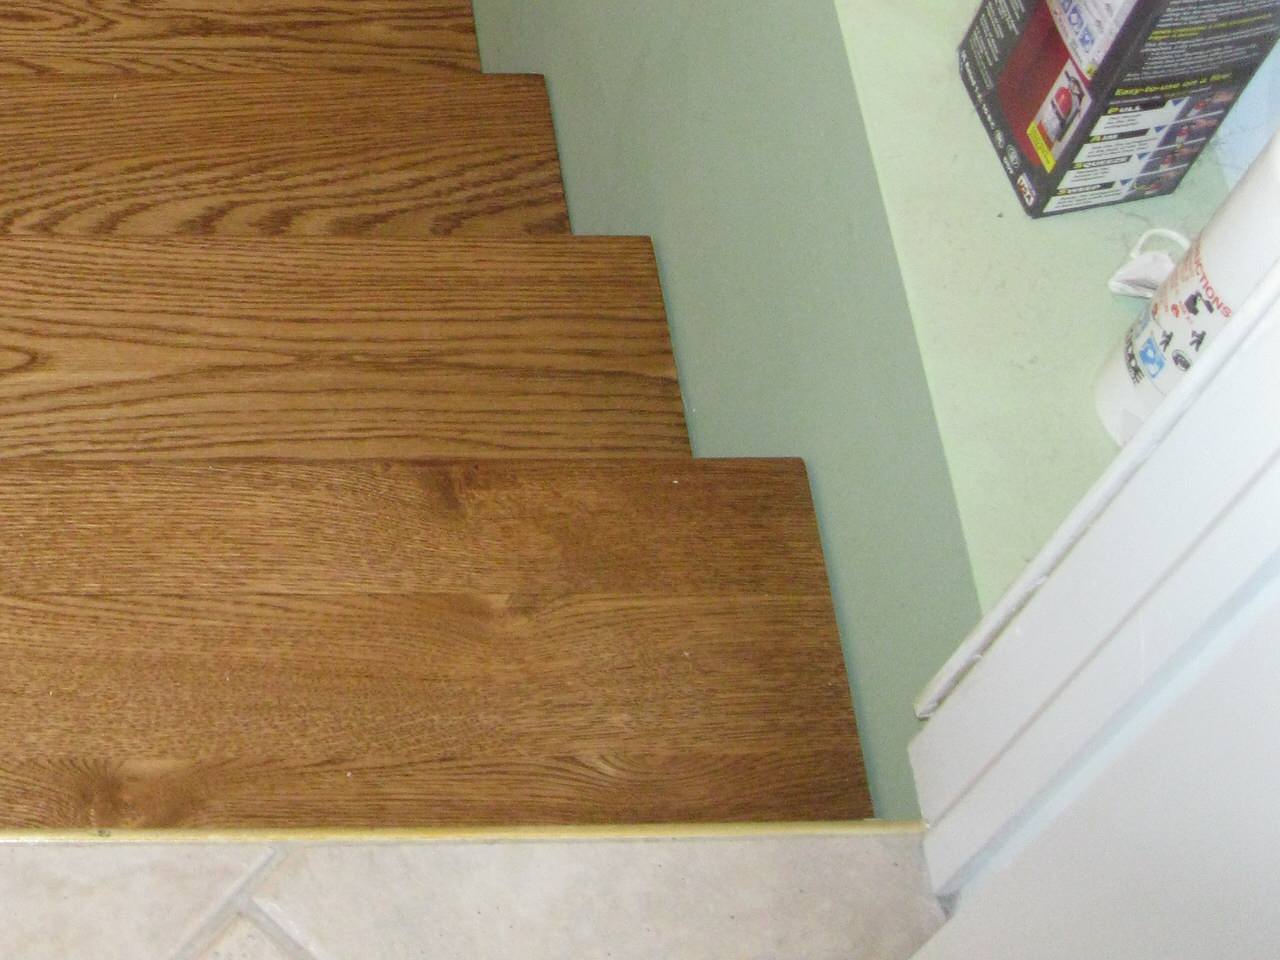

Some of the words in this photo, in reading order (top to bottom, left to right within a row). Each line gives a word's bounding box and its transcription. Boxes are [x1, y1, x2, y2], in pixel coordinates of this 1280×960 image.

[1114, 79, 1182, 97] Easy-to-use
[1106, 104, 1141, 115] PULL
[1056, 183, 1102, 196] SWEEP
